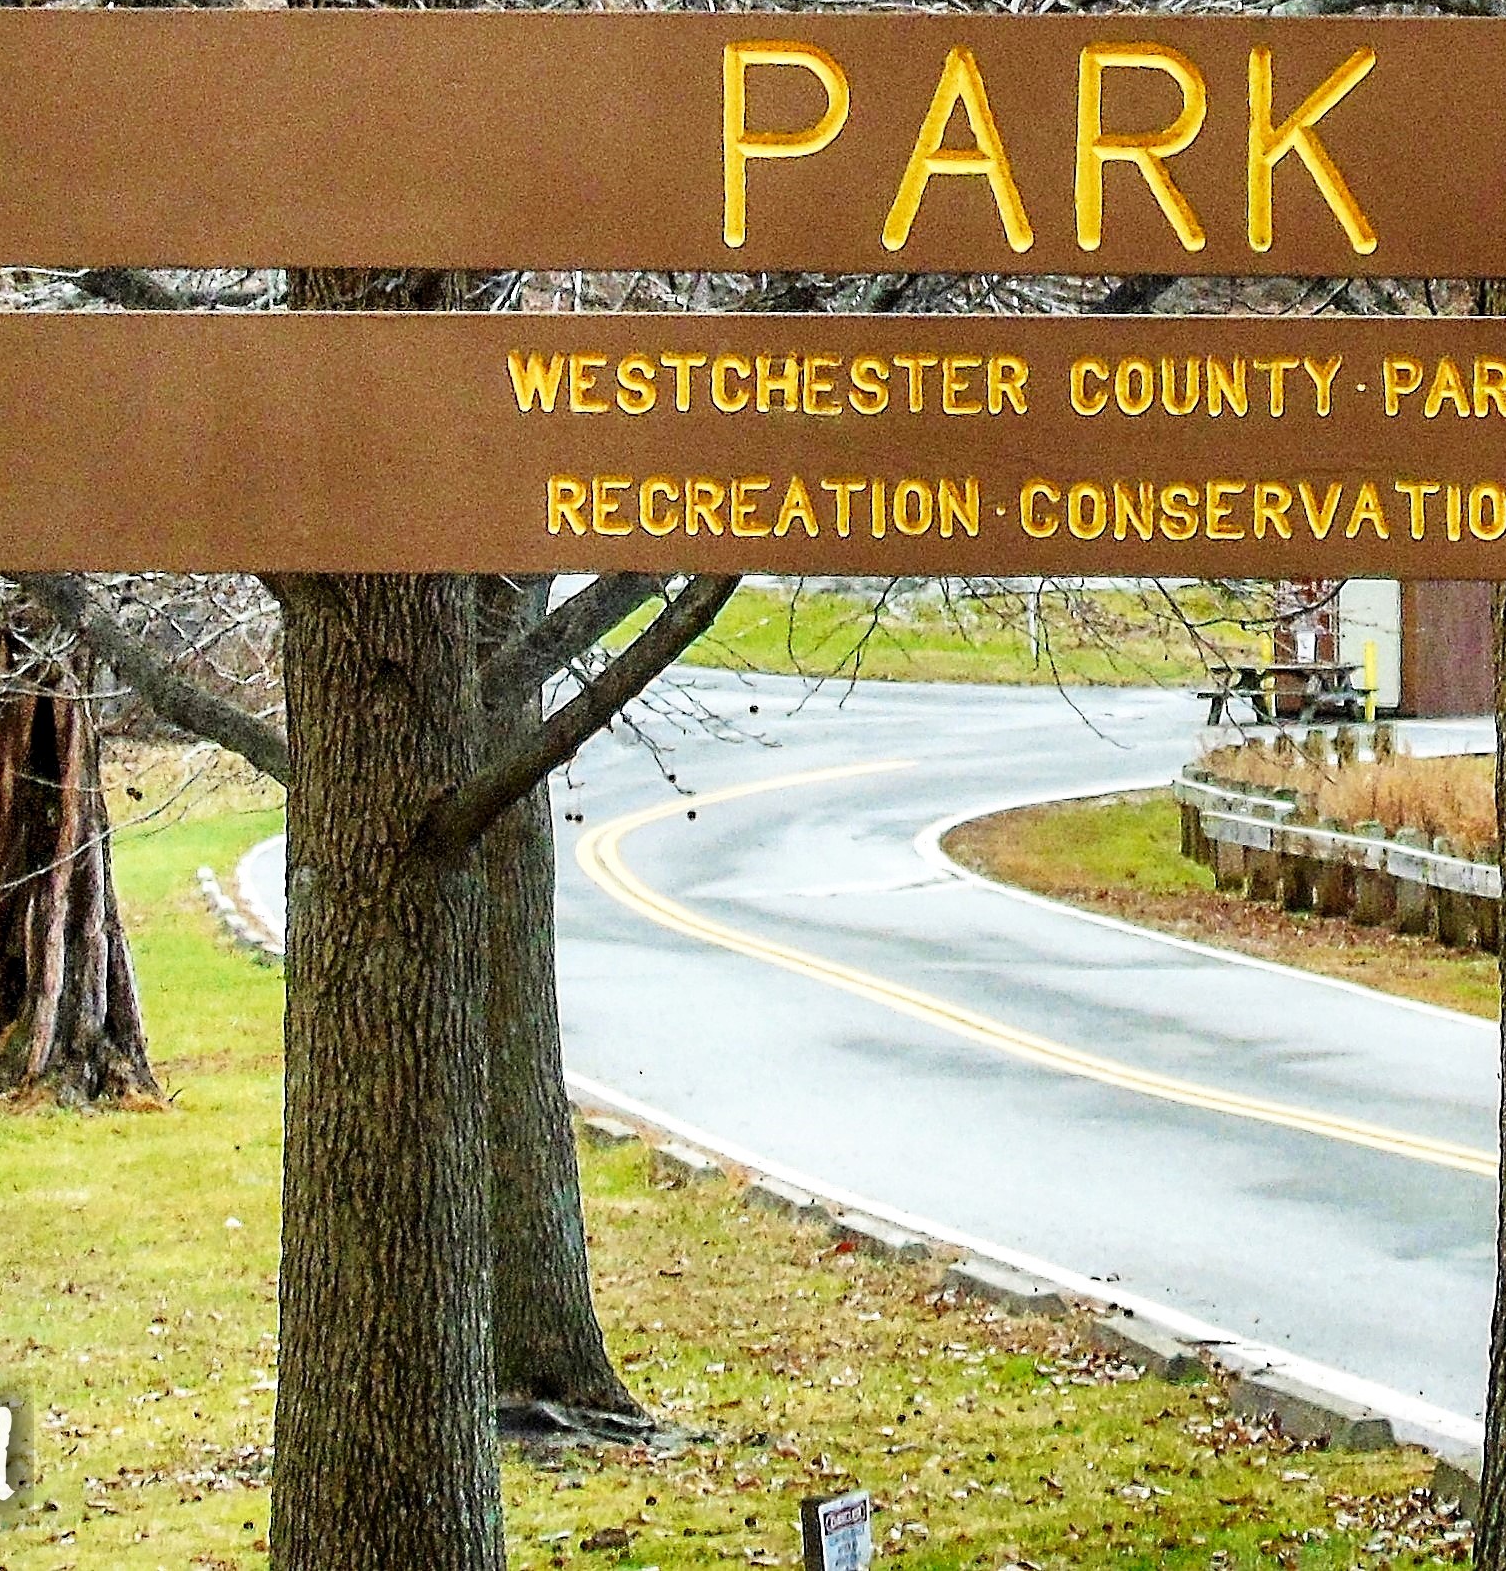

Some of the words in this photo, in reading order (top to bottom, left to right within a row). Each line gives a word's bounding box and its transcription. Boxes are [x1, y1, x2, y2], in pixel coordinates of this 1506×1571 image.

[721, 41, 1380, 256] PARK
[507, 350, 1030, 416] WESTCHESTER
[1069, 355, 1342, 417] COUNTY
[546, 475, 980, 538] RECREATION
